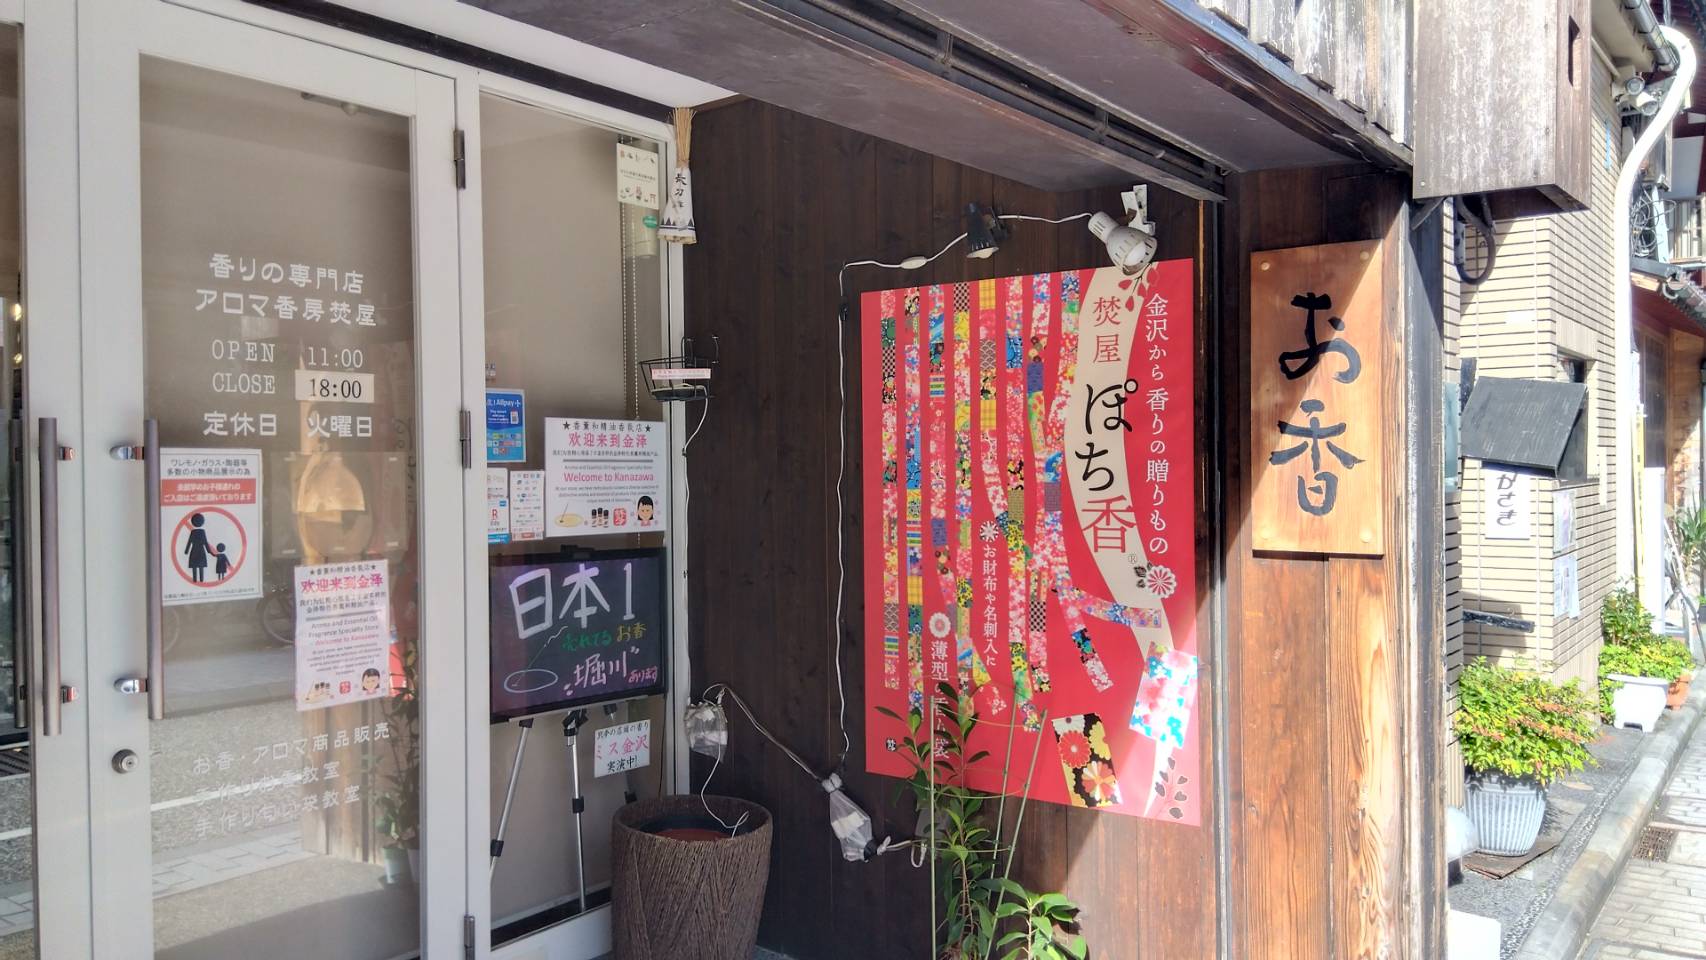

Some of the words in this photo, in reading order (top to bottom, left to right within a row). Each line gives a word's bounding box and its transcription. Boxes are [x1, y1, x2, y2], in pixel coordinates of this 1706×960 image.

[209, 253, 364, 294] 香りの専門店
[195, 288, 376, 326] アロマ香房焚屋
[1093, 295, 1120, 363] 焚屋
[212, 339, 275, 363] OPEN
[308, 347, 363, 368] 11:00
[212, 372, 275, 394] CLOSE
[309, 377, 362, 399] 18:00
[1269, 292, 1366, 517] お香
[203, 411, 277, 436] 定休日
[307, 410, 372, 437] 火曜日
[568, 432, 647, 448] 欢迎来到金泽
[1145, 293, 1169, 554] 金沢から香りの贈りもの
[563, 472, 602, 482] Welcome
[604, 473, 613, 482] to
[615, 472, 654, 482] Kanazawa
[1074, 378, 1138, 553] ぽち香
[301, 573, 384, 593] 欢迎来到金泽
[509, 562, 636, 640] 日本1
[982, 544, 998, 666] お財布や名刺入に
[617, 622, 647, 642] お香
[193, 722, 390, 775] お香・アロマ商品販売
[597, 734, 649, 760] ミス金沢
